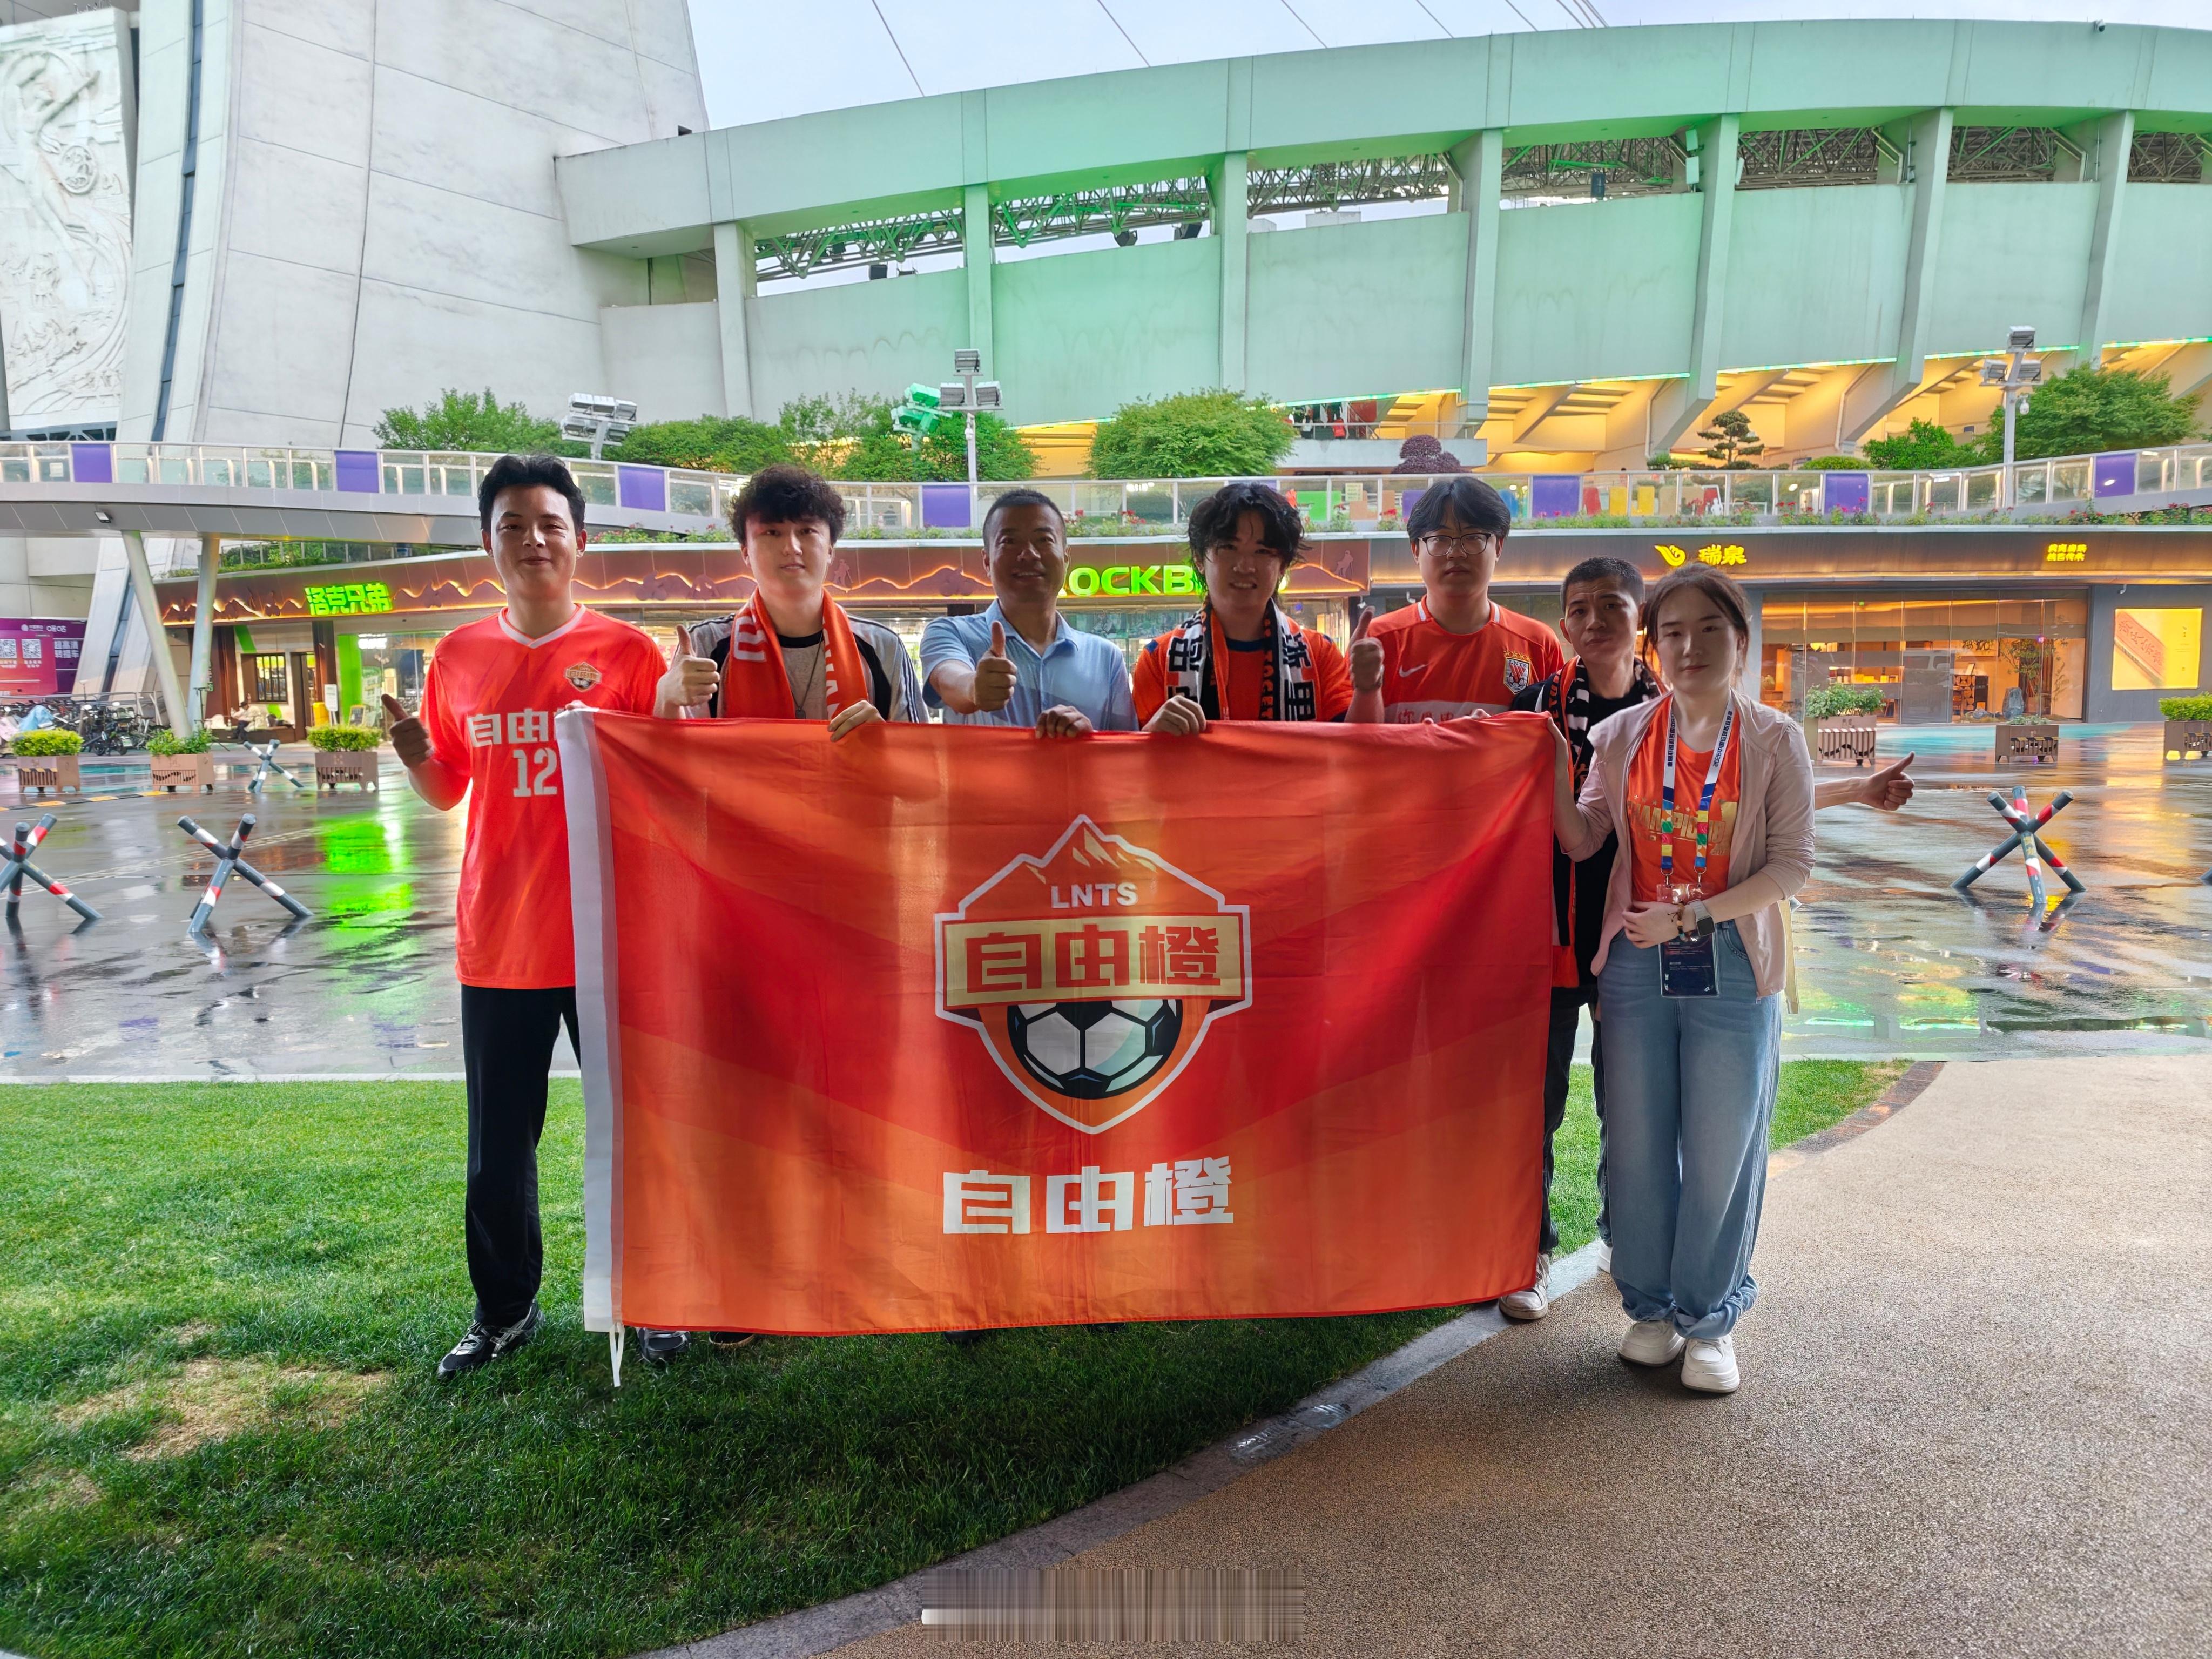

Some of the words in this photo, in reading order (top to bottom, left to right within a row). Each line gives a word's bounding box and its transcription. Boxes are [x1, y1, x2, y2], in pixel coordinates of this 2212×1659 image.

[1060, 565, 1203, 596] OCKB
[304, 582, 393, 616] 洛克兄弟
[1509, 659, 1527, 668] LNTS
[468, 708, 556, 747] 自由
[514, 747, 557, 797] 12
[1050, 882, 1139, 909] LNTS
[966, 924, 1221, 993] 自由橙
[943, 1156, 1234, 1235] 自由橙
